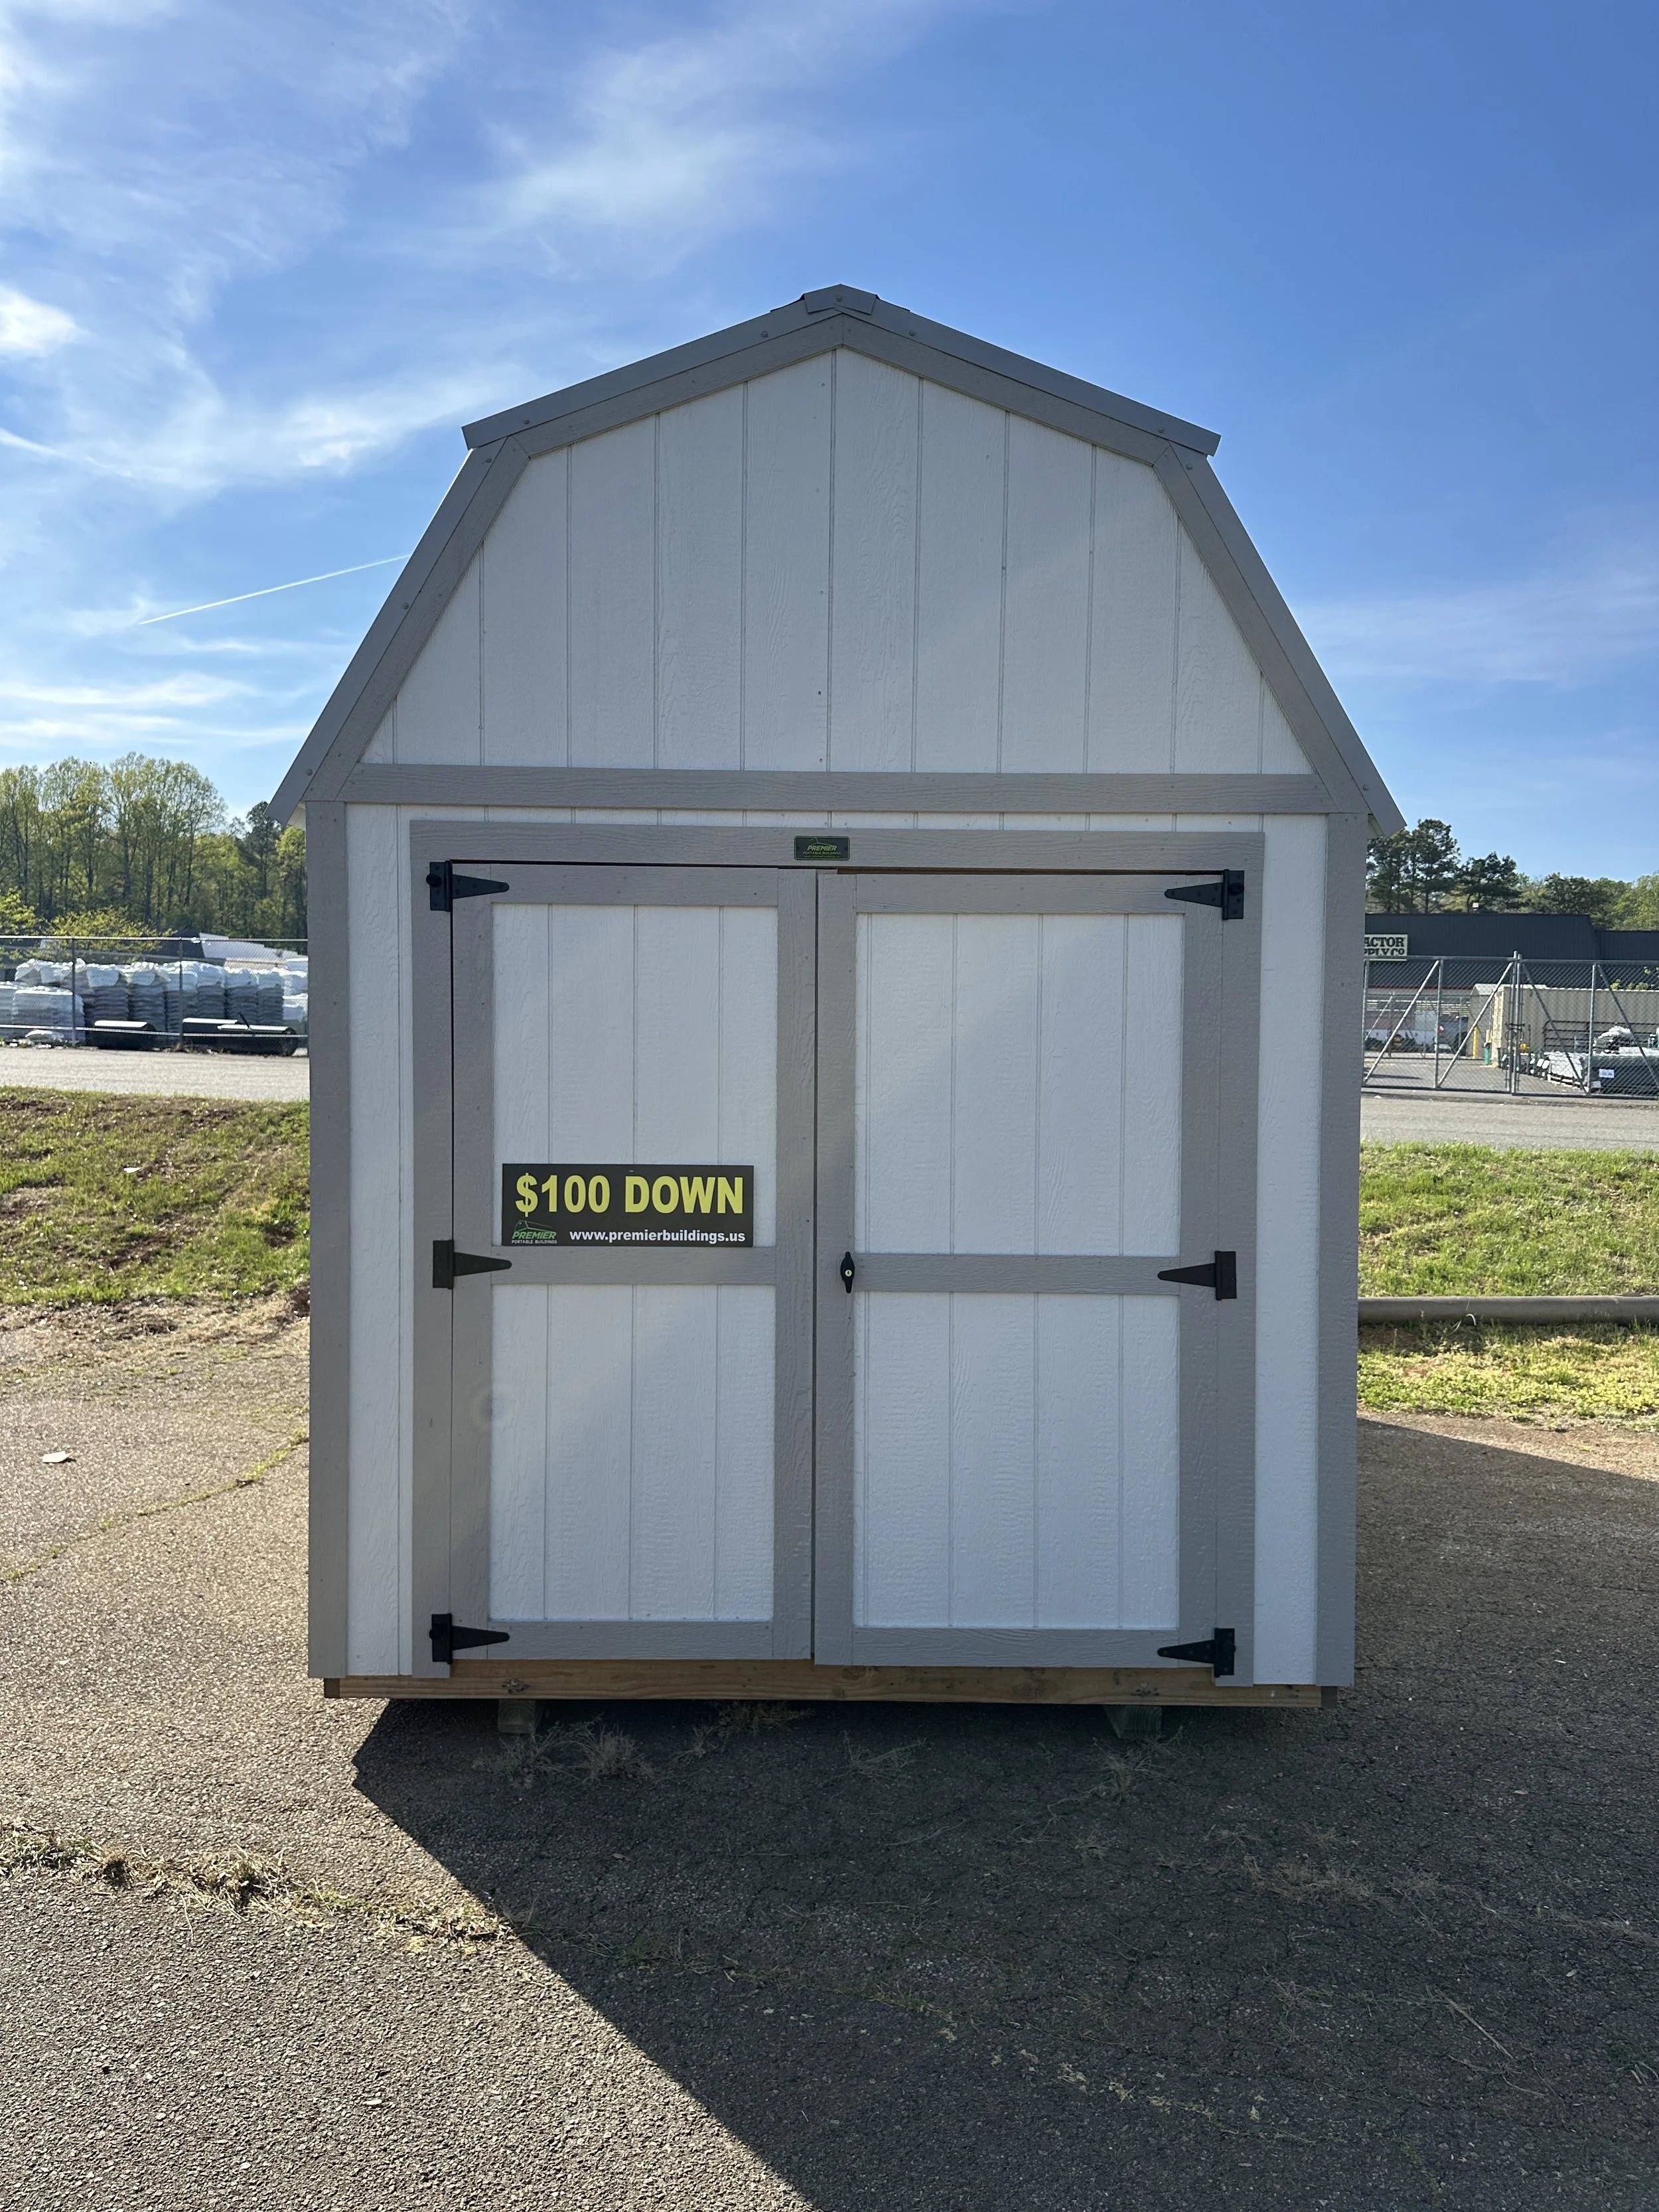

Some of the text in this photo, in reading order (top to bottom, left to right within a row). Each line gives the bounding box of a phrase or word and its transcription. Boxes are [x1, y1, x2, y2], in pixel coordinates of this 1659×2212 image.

[515, 1173, 743, 1217] $100 DOWN
[569, 1229, 746, 1244] www.premierbuildings.us
